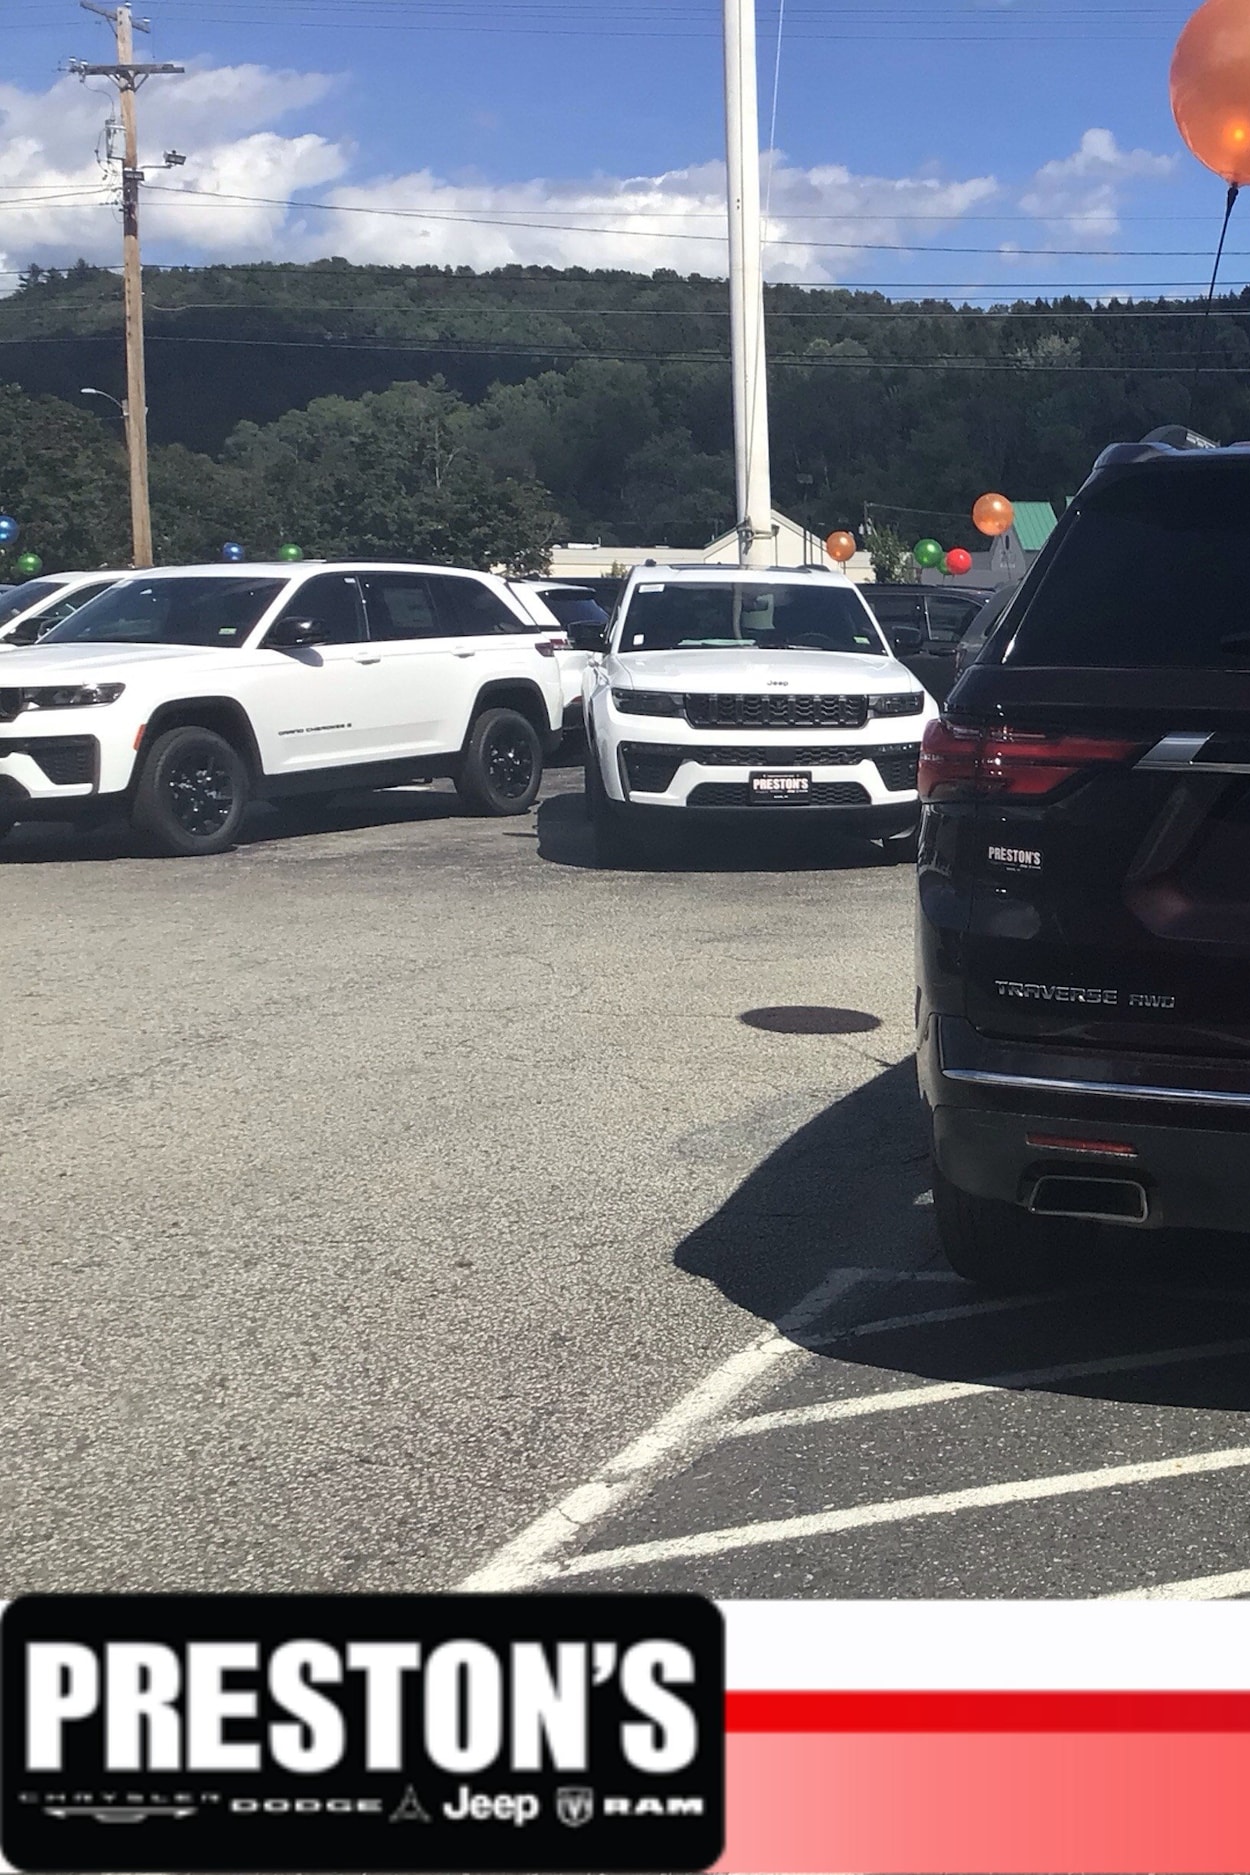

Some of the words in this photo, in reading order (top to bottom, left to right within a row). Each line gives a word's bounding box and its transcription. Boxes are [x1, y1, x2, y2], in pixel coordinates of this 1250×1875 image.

[753, 778, 809, 790] PRESTON'S
[988, 846, 1041, 865] PRESTON'S
[995, 980, 1118, 1005] TRAVERSE
[1129, 993, 1175, 1009] AWD
